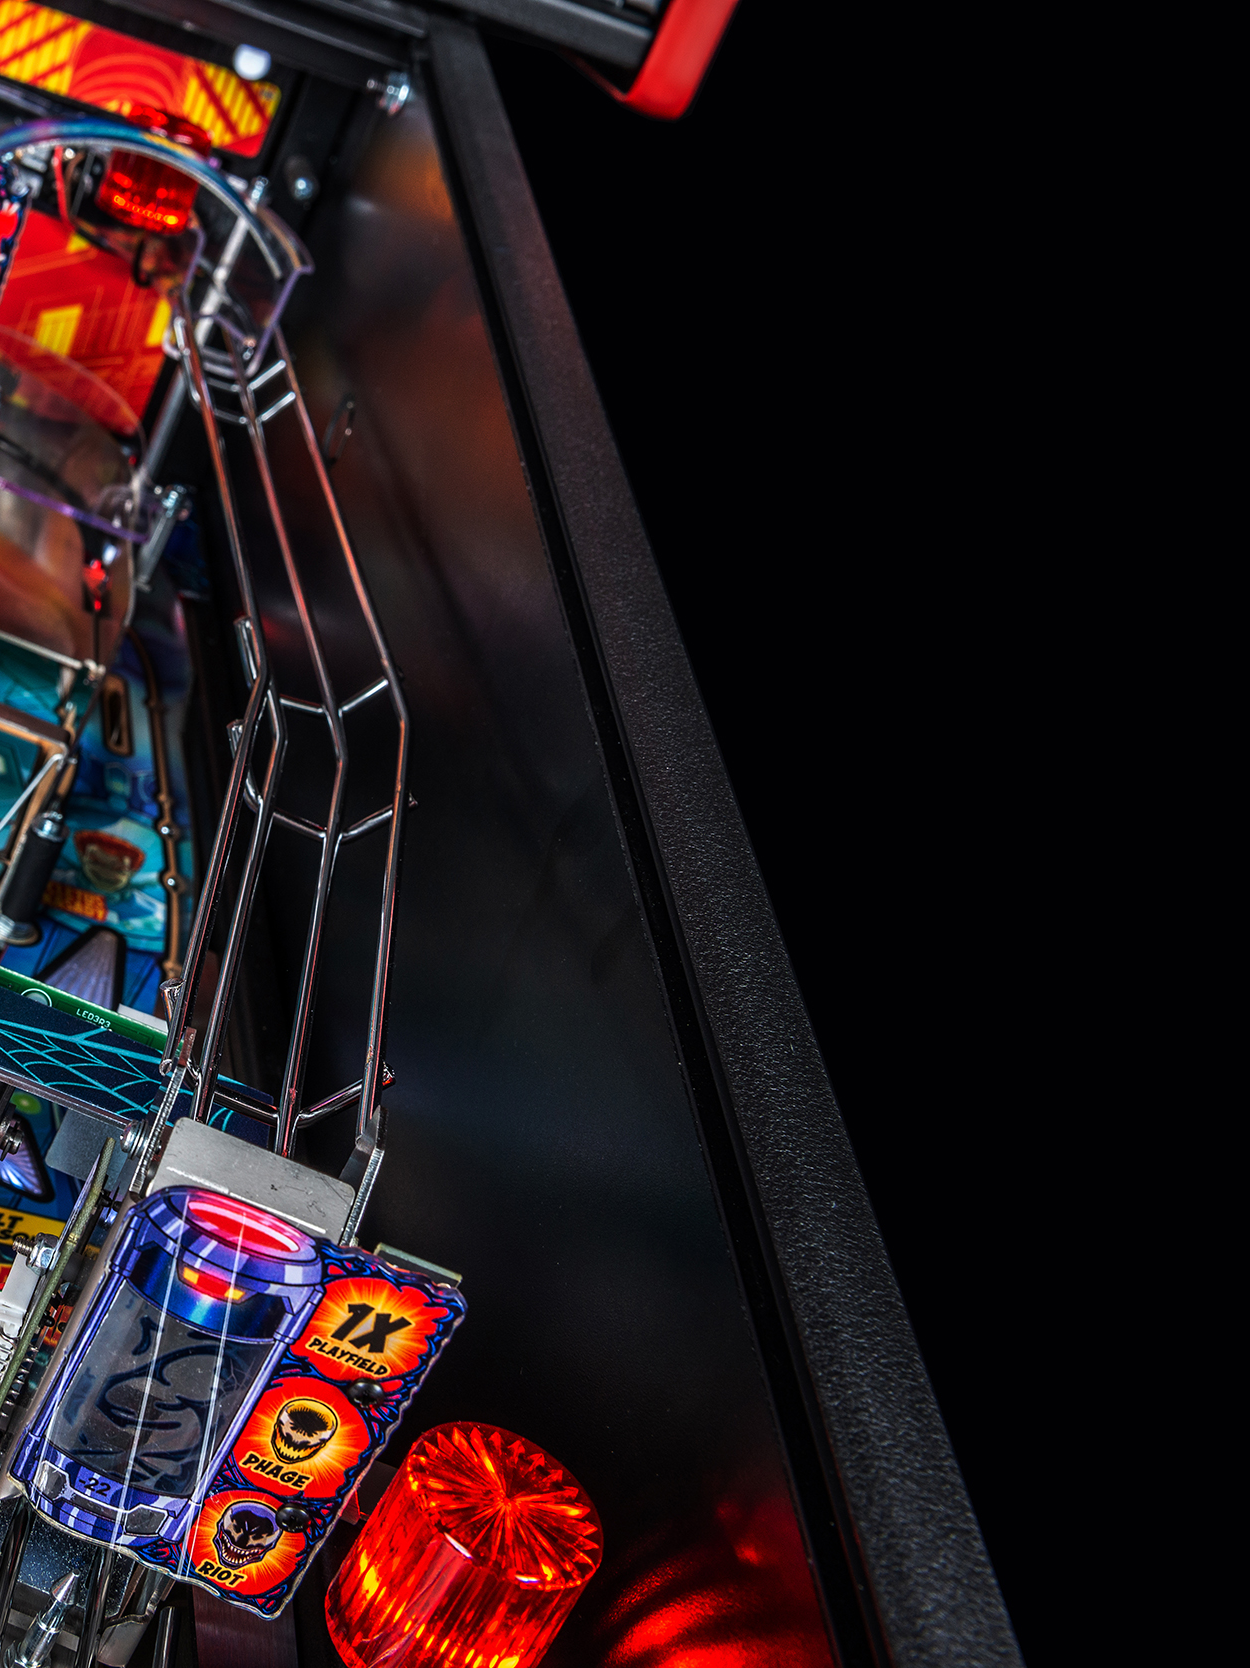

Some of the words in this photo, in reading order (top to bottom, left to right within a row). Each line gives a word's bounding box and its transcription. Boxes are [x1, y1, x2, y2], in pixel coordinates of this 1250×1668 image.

[330, 1303, 413, 1353] 1X
[308, 1336, 388, 1376] PLAYFIELD
[78, 1477, 111, 1497] -22
[242, 1453, 310, 1489] PHAGE
[197, 1560, 244, 1586] RIOT
